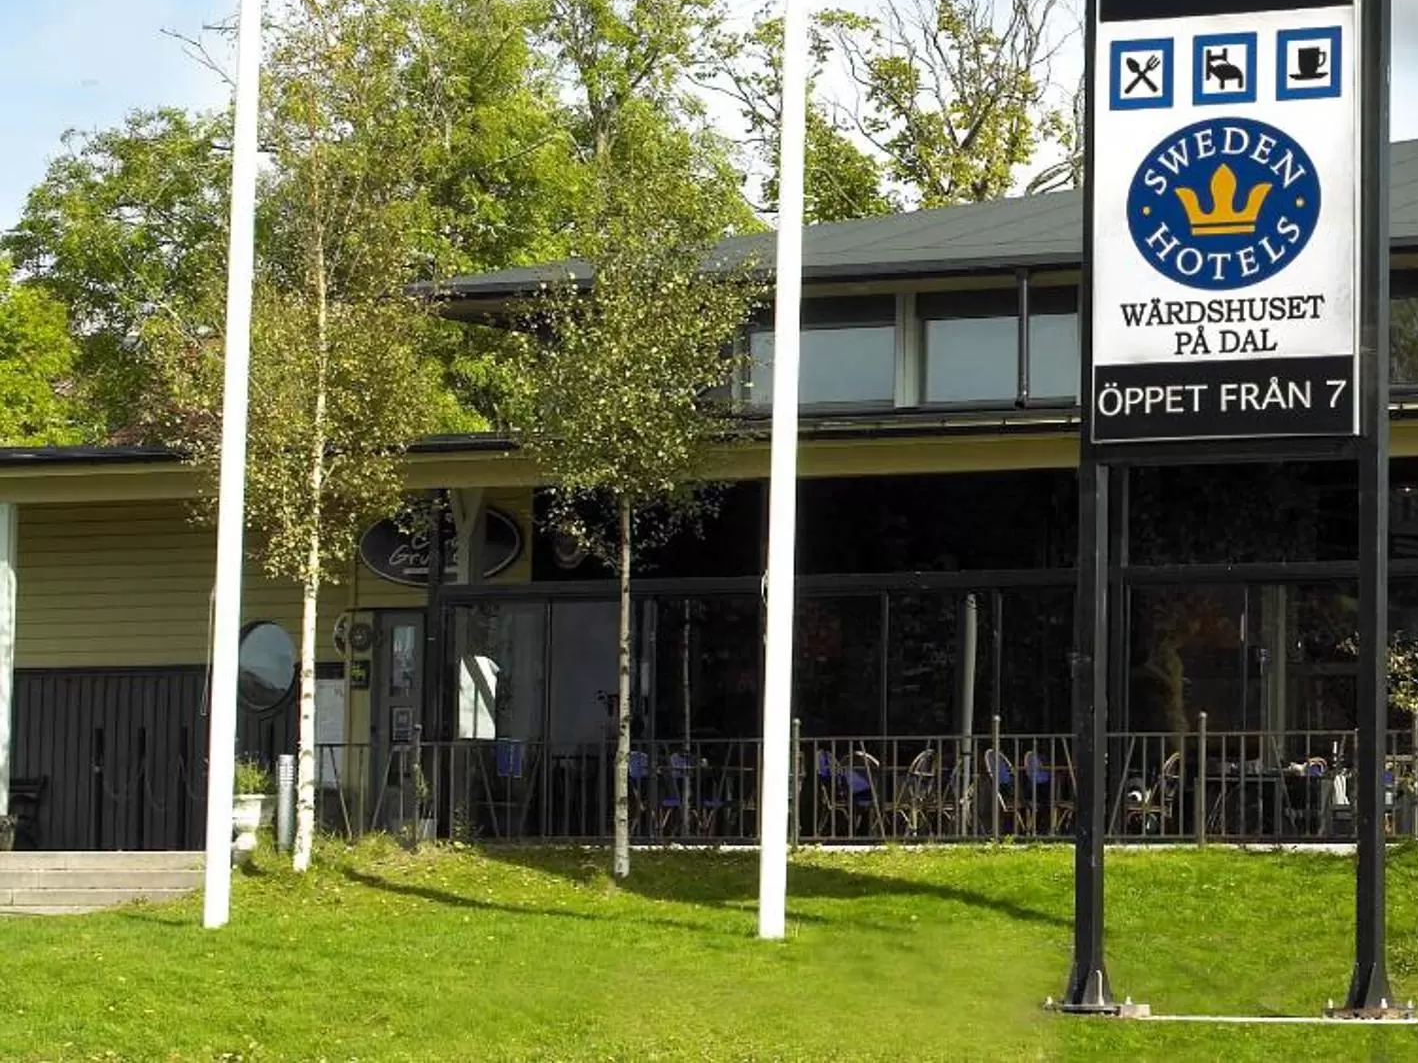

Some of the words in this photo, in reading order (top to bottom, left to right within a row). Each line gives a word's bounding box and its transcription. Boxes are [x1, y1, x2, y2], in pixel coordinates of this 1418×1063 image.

[1144, 126, 1306, 195] SWEDEN
[1146, 216, 1300, 280] HOTELS
[1120, 294, 1325, 327] WÄRDSHUSET
[1173, 325, 1211, 356] PÅ
[1218, 328, 1278, 354] DAL
[1098, 382, 1209, 416] ÖPPET
[1219, 377, 1312, 413] FRÅN
[1326, 380, 1347, 408] 7
